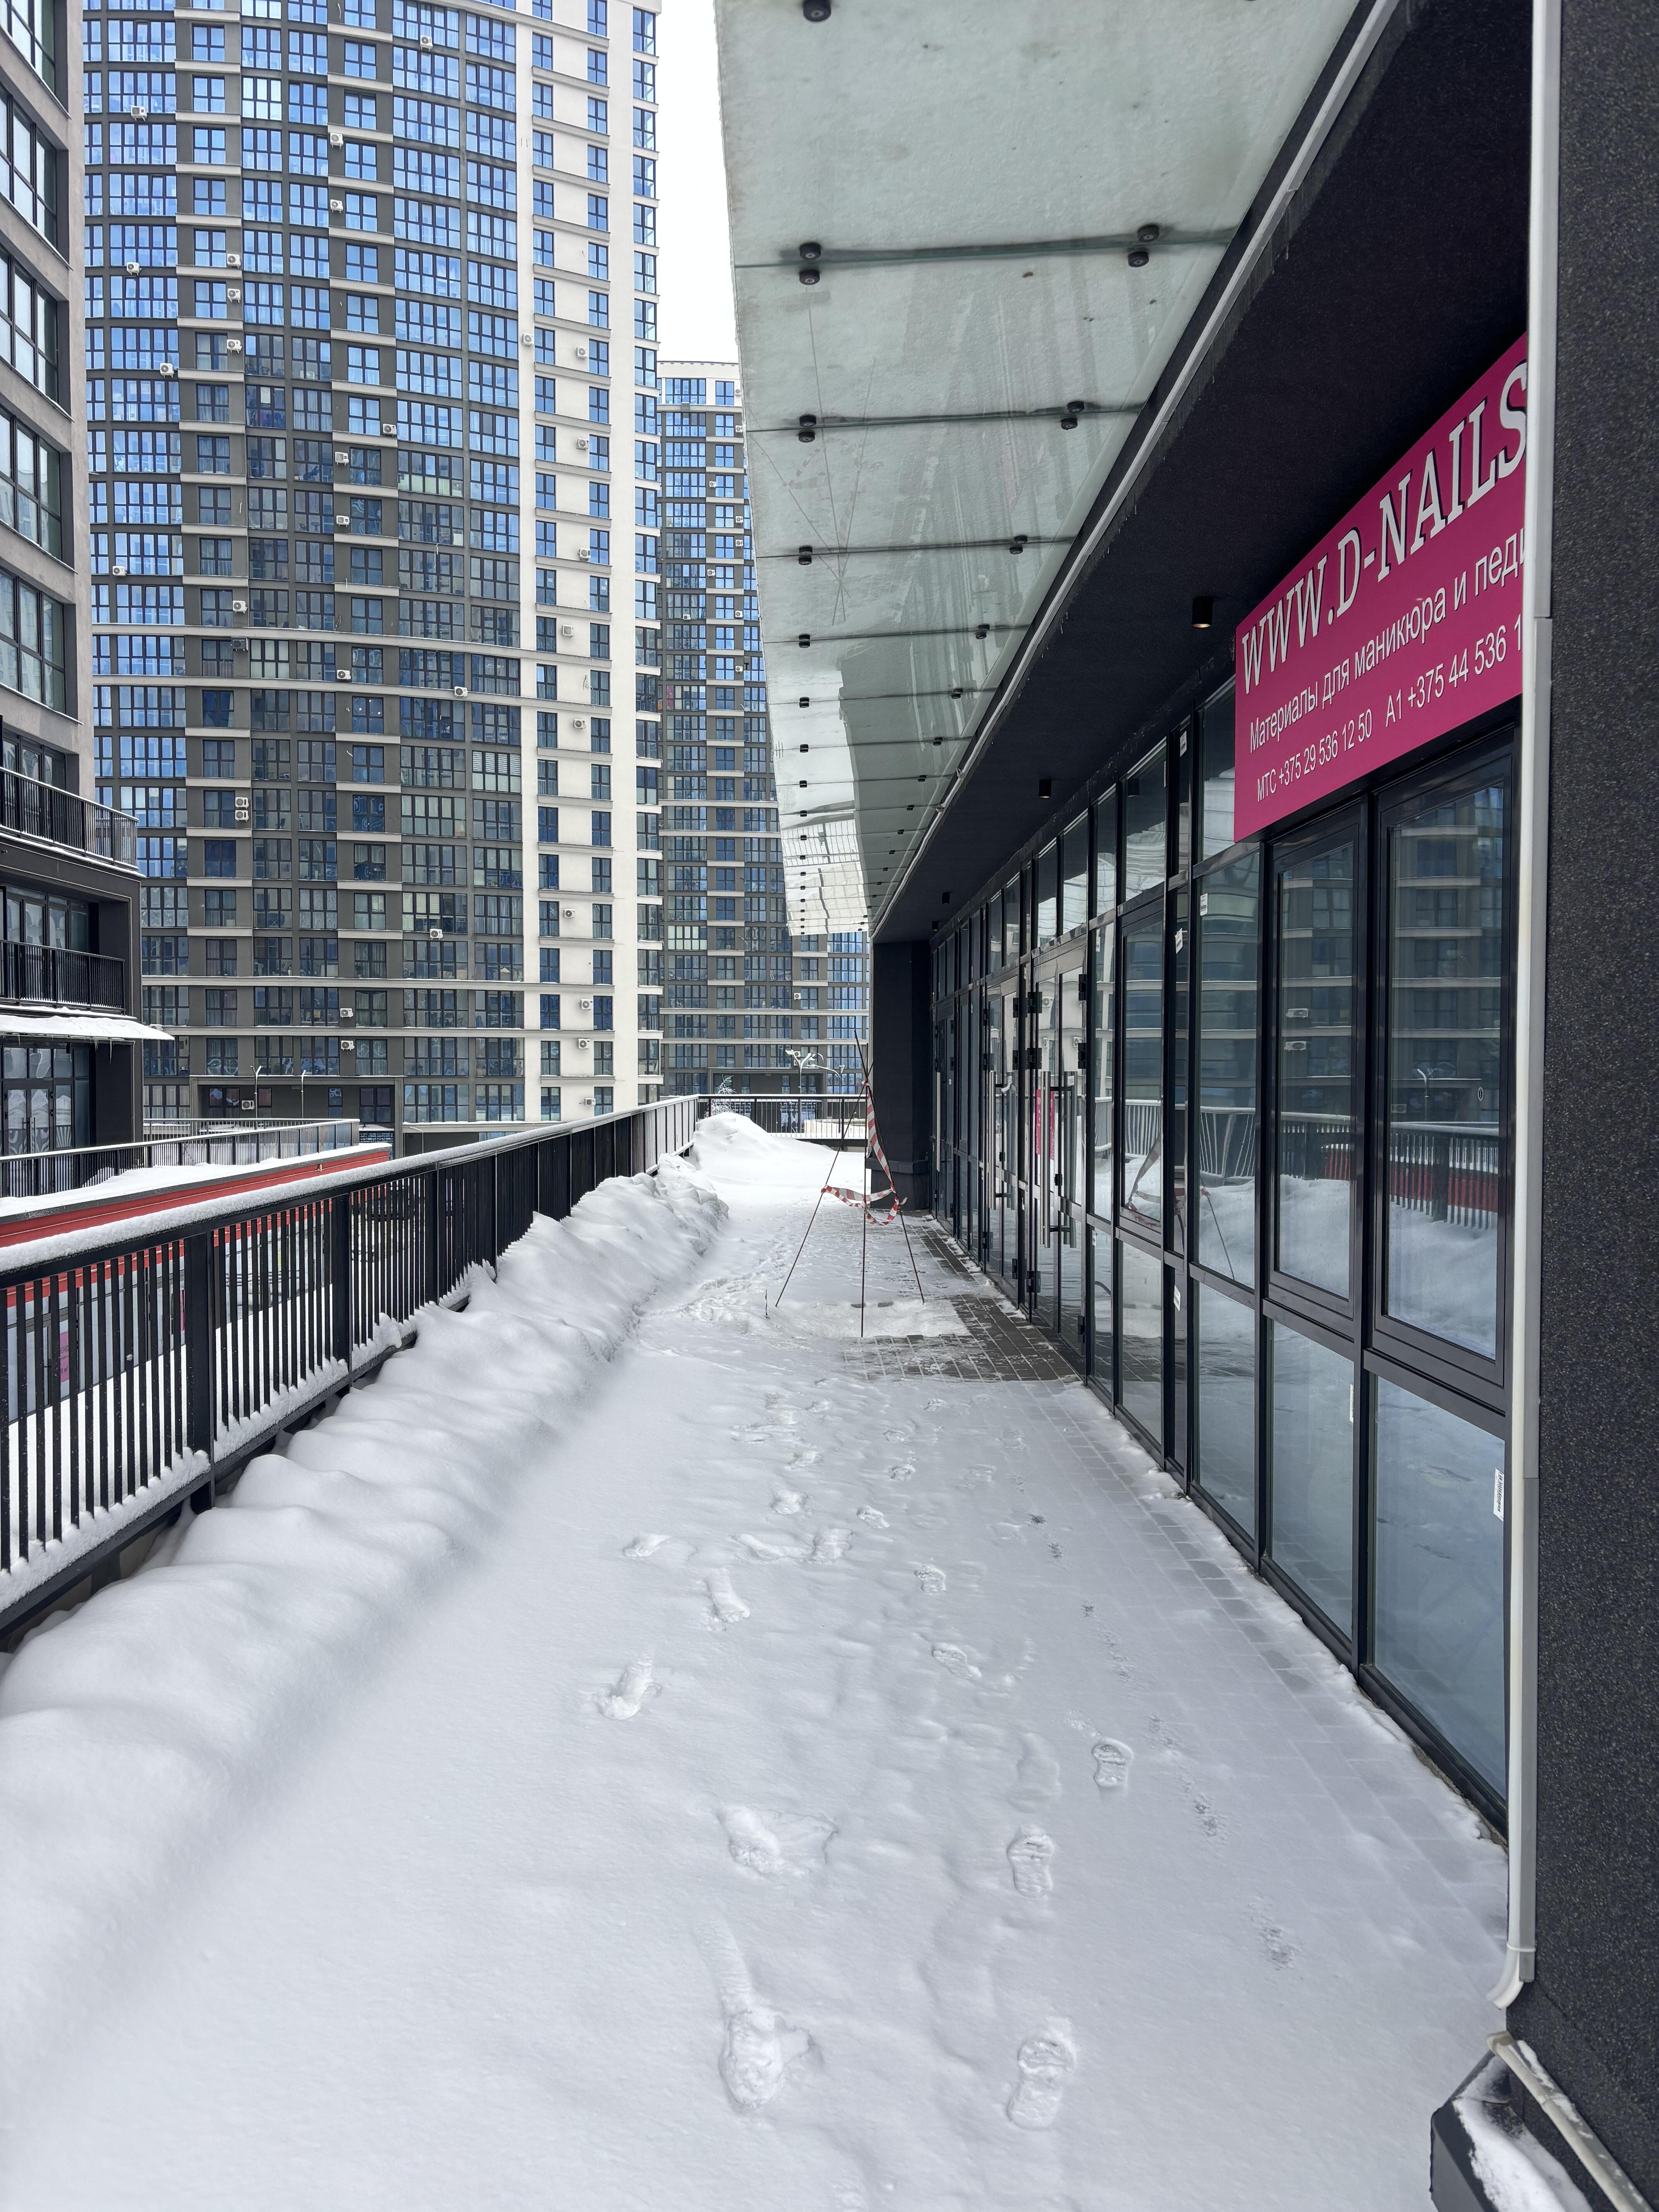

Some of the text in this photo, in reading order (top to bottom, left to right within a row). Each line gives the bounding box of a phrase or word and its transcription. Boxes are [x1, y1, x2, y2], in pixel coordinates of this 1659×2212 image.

[1242, 362, 1527, 695] WWW.D-NAILS
[1250, 681, 1318, 754] Материалы
[1322, 658, 1350, 710] для
[1355, 587, 1446, 680] маникюра
[1454, 570, 1467, 611] и
[1257, 768, 1277, 802] МТС
[1279, 752, 1302, 786] +375
[1304, 744, 1316, 775] 29
[1319, 730, 1338, 766] 536
[1342, 719, 1355, 752] 12
[1358, 708, 1372, 743] 50
[1385, 689, 1402, 728] A1
[1407, 663, 1444, 708] +375
[1448, 647, 1469, 688] 44
[1474, 625, 1506, 675] 536
